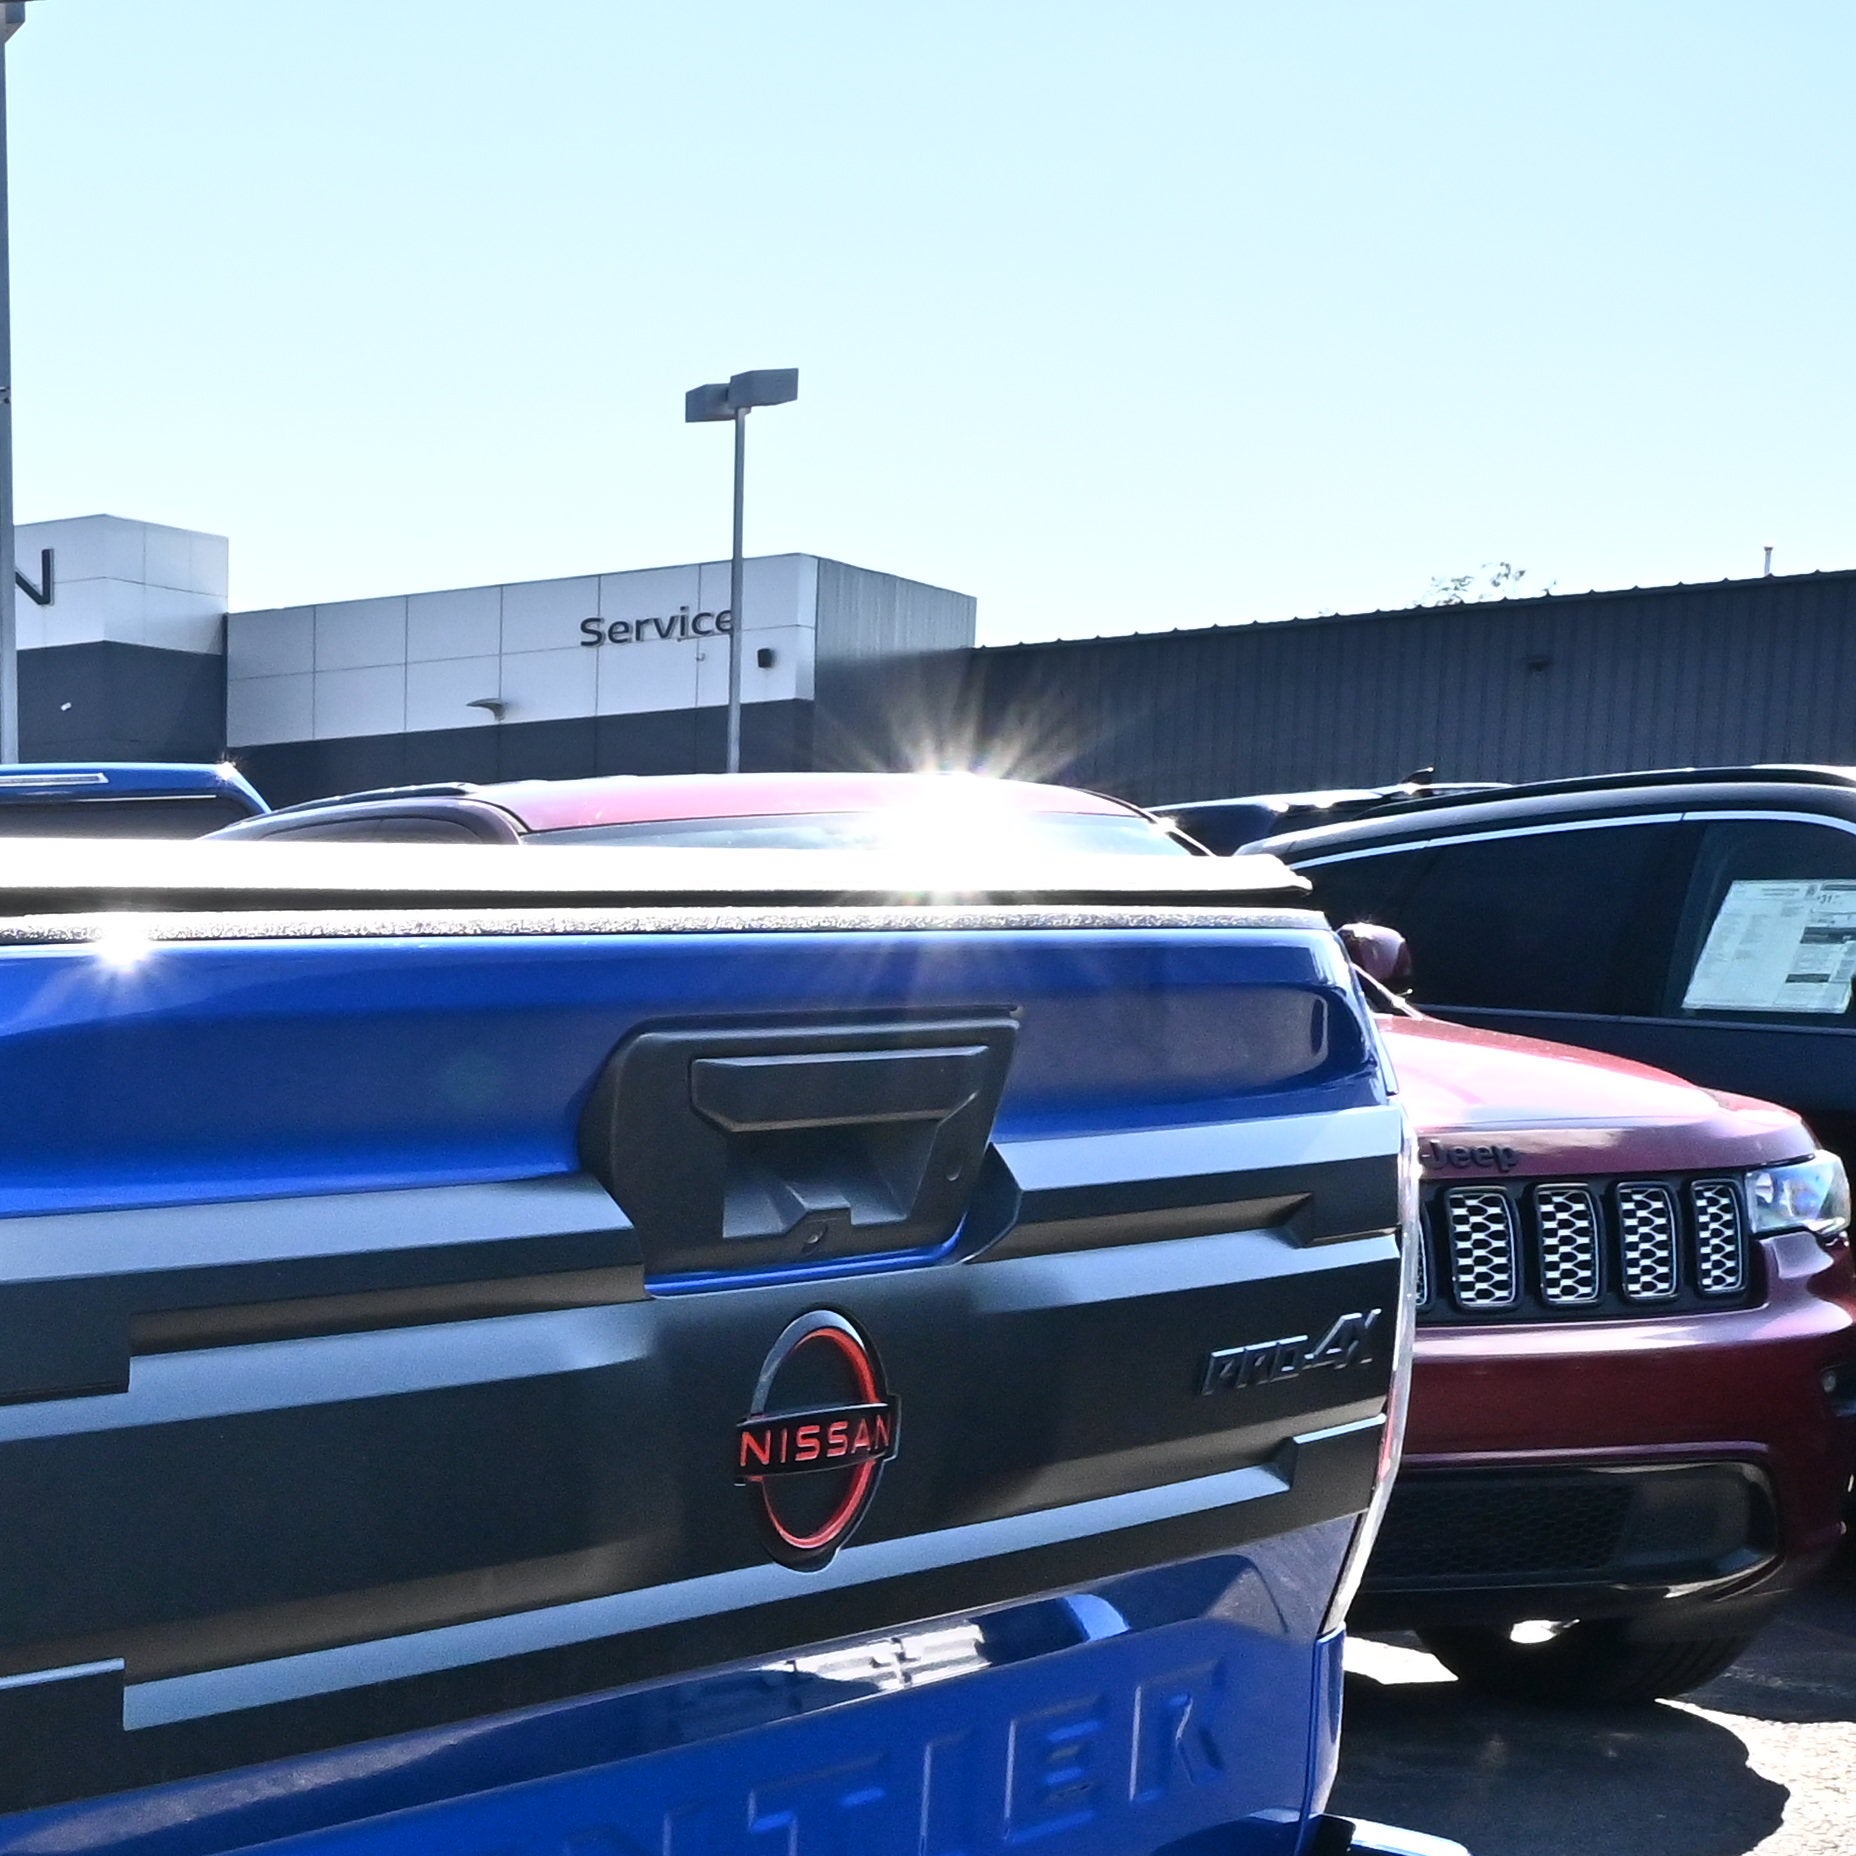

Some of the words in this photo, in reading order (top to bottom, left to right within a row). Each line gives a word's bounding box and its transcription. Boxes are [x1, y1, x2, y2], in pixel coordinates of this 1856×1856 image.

[580, 606, 734, 647] Service
[1419, 1139, 1520, 1173] Jeep
[739, 1414, 890, 1467] NISSAN
